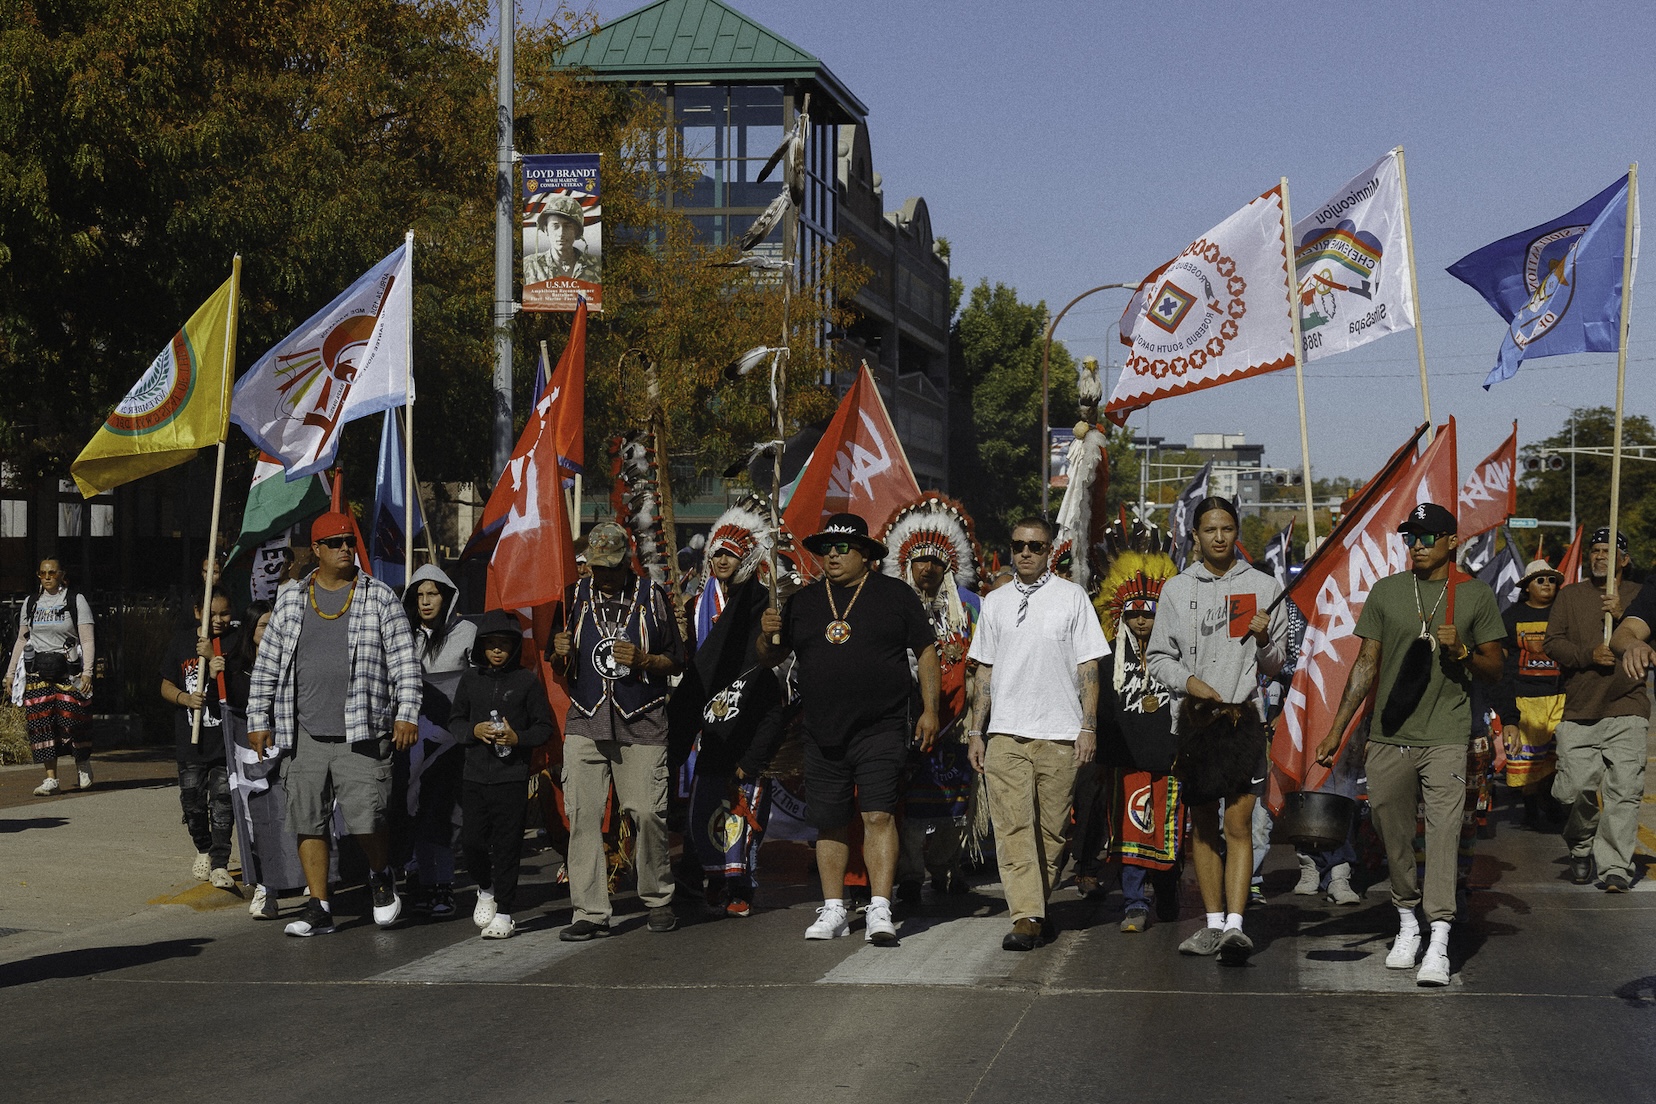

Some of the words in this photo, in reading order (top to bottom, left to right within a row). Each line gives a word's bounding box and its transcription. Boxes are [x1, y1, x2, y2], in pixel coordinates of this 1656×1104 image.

[526, 169, 554, 179] LOYD
[556, 168, 597, 178] BRANDT
[545, 281, 580, 289] U.S.M.C.
[732, 679, 747, 690] ON
